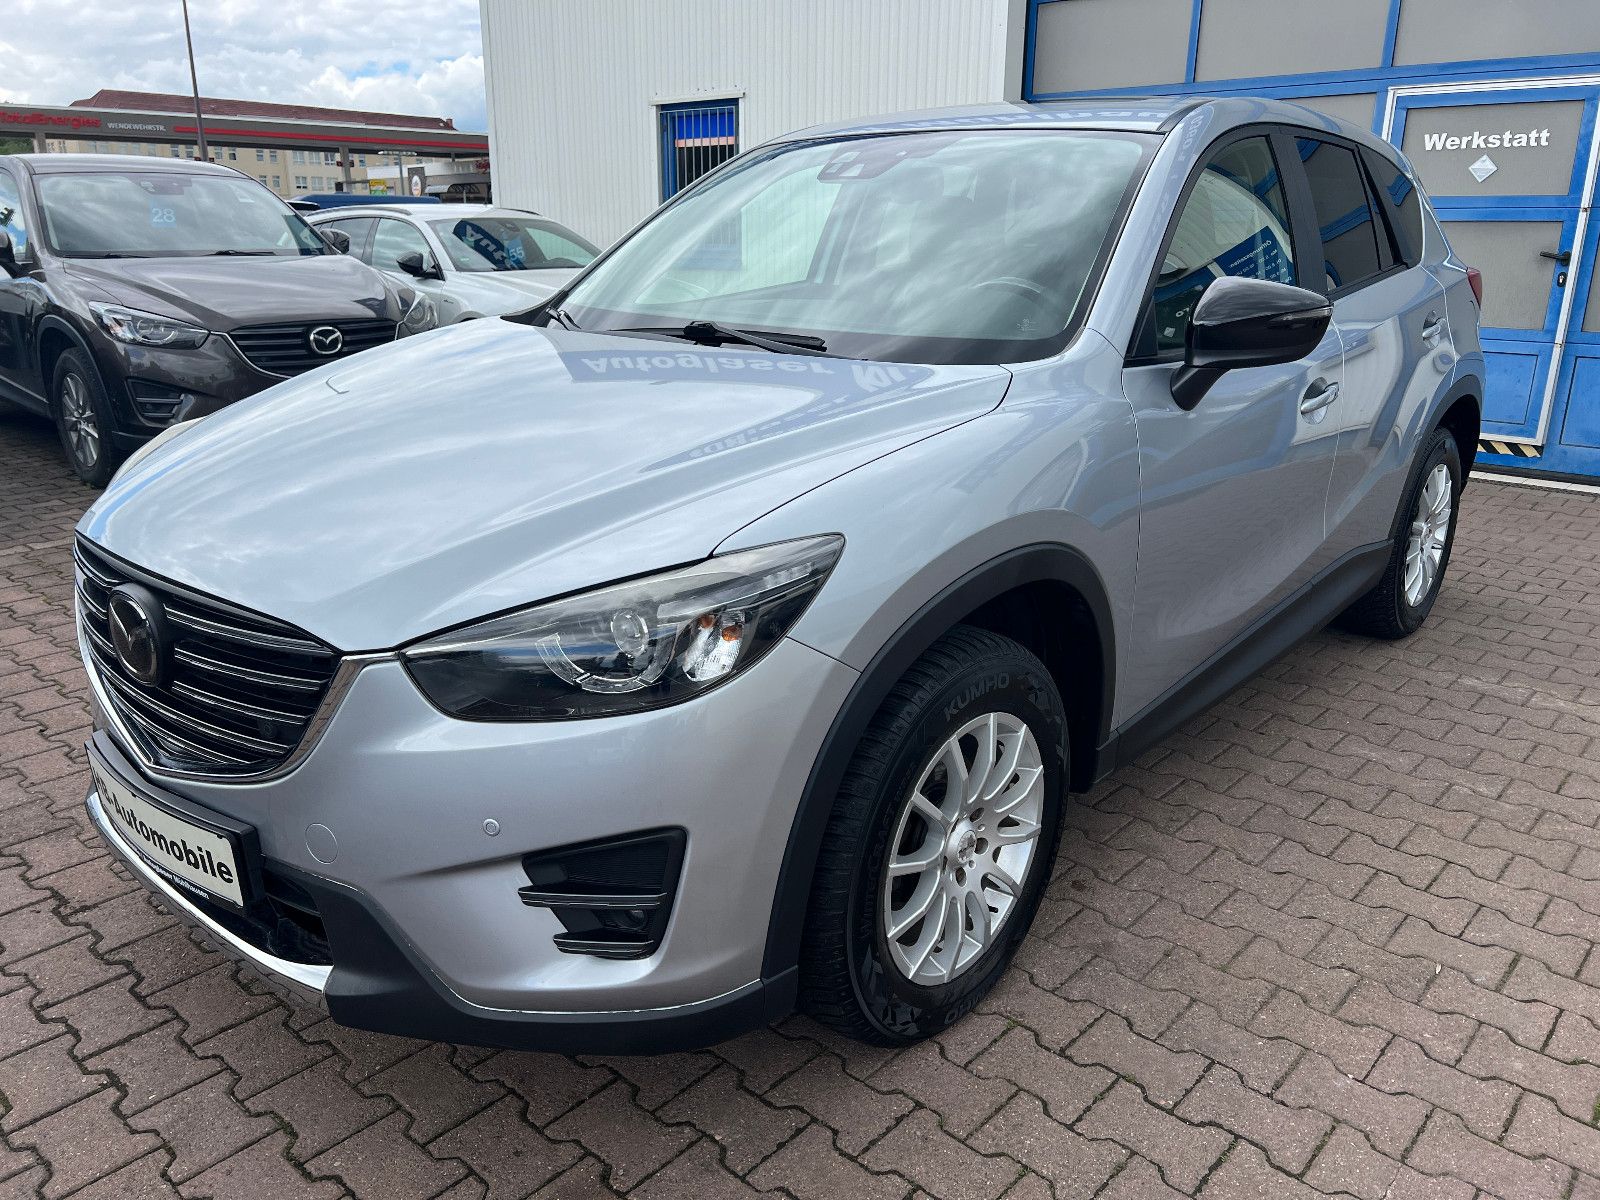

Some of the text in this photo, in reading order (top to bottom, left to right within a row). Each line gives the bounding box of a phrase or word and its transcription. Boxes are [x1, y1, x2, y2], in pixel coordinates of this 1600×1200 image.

[1424, 128, 1550, 151] Werkstatt
[152, 208, 176, 223] 28
[509, 247, 525, 261] 55
[943, 671, 1010, 722] KUMHO
